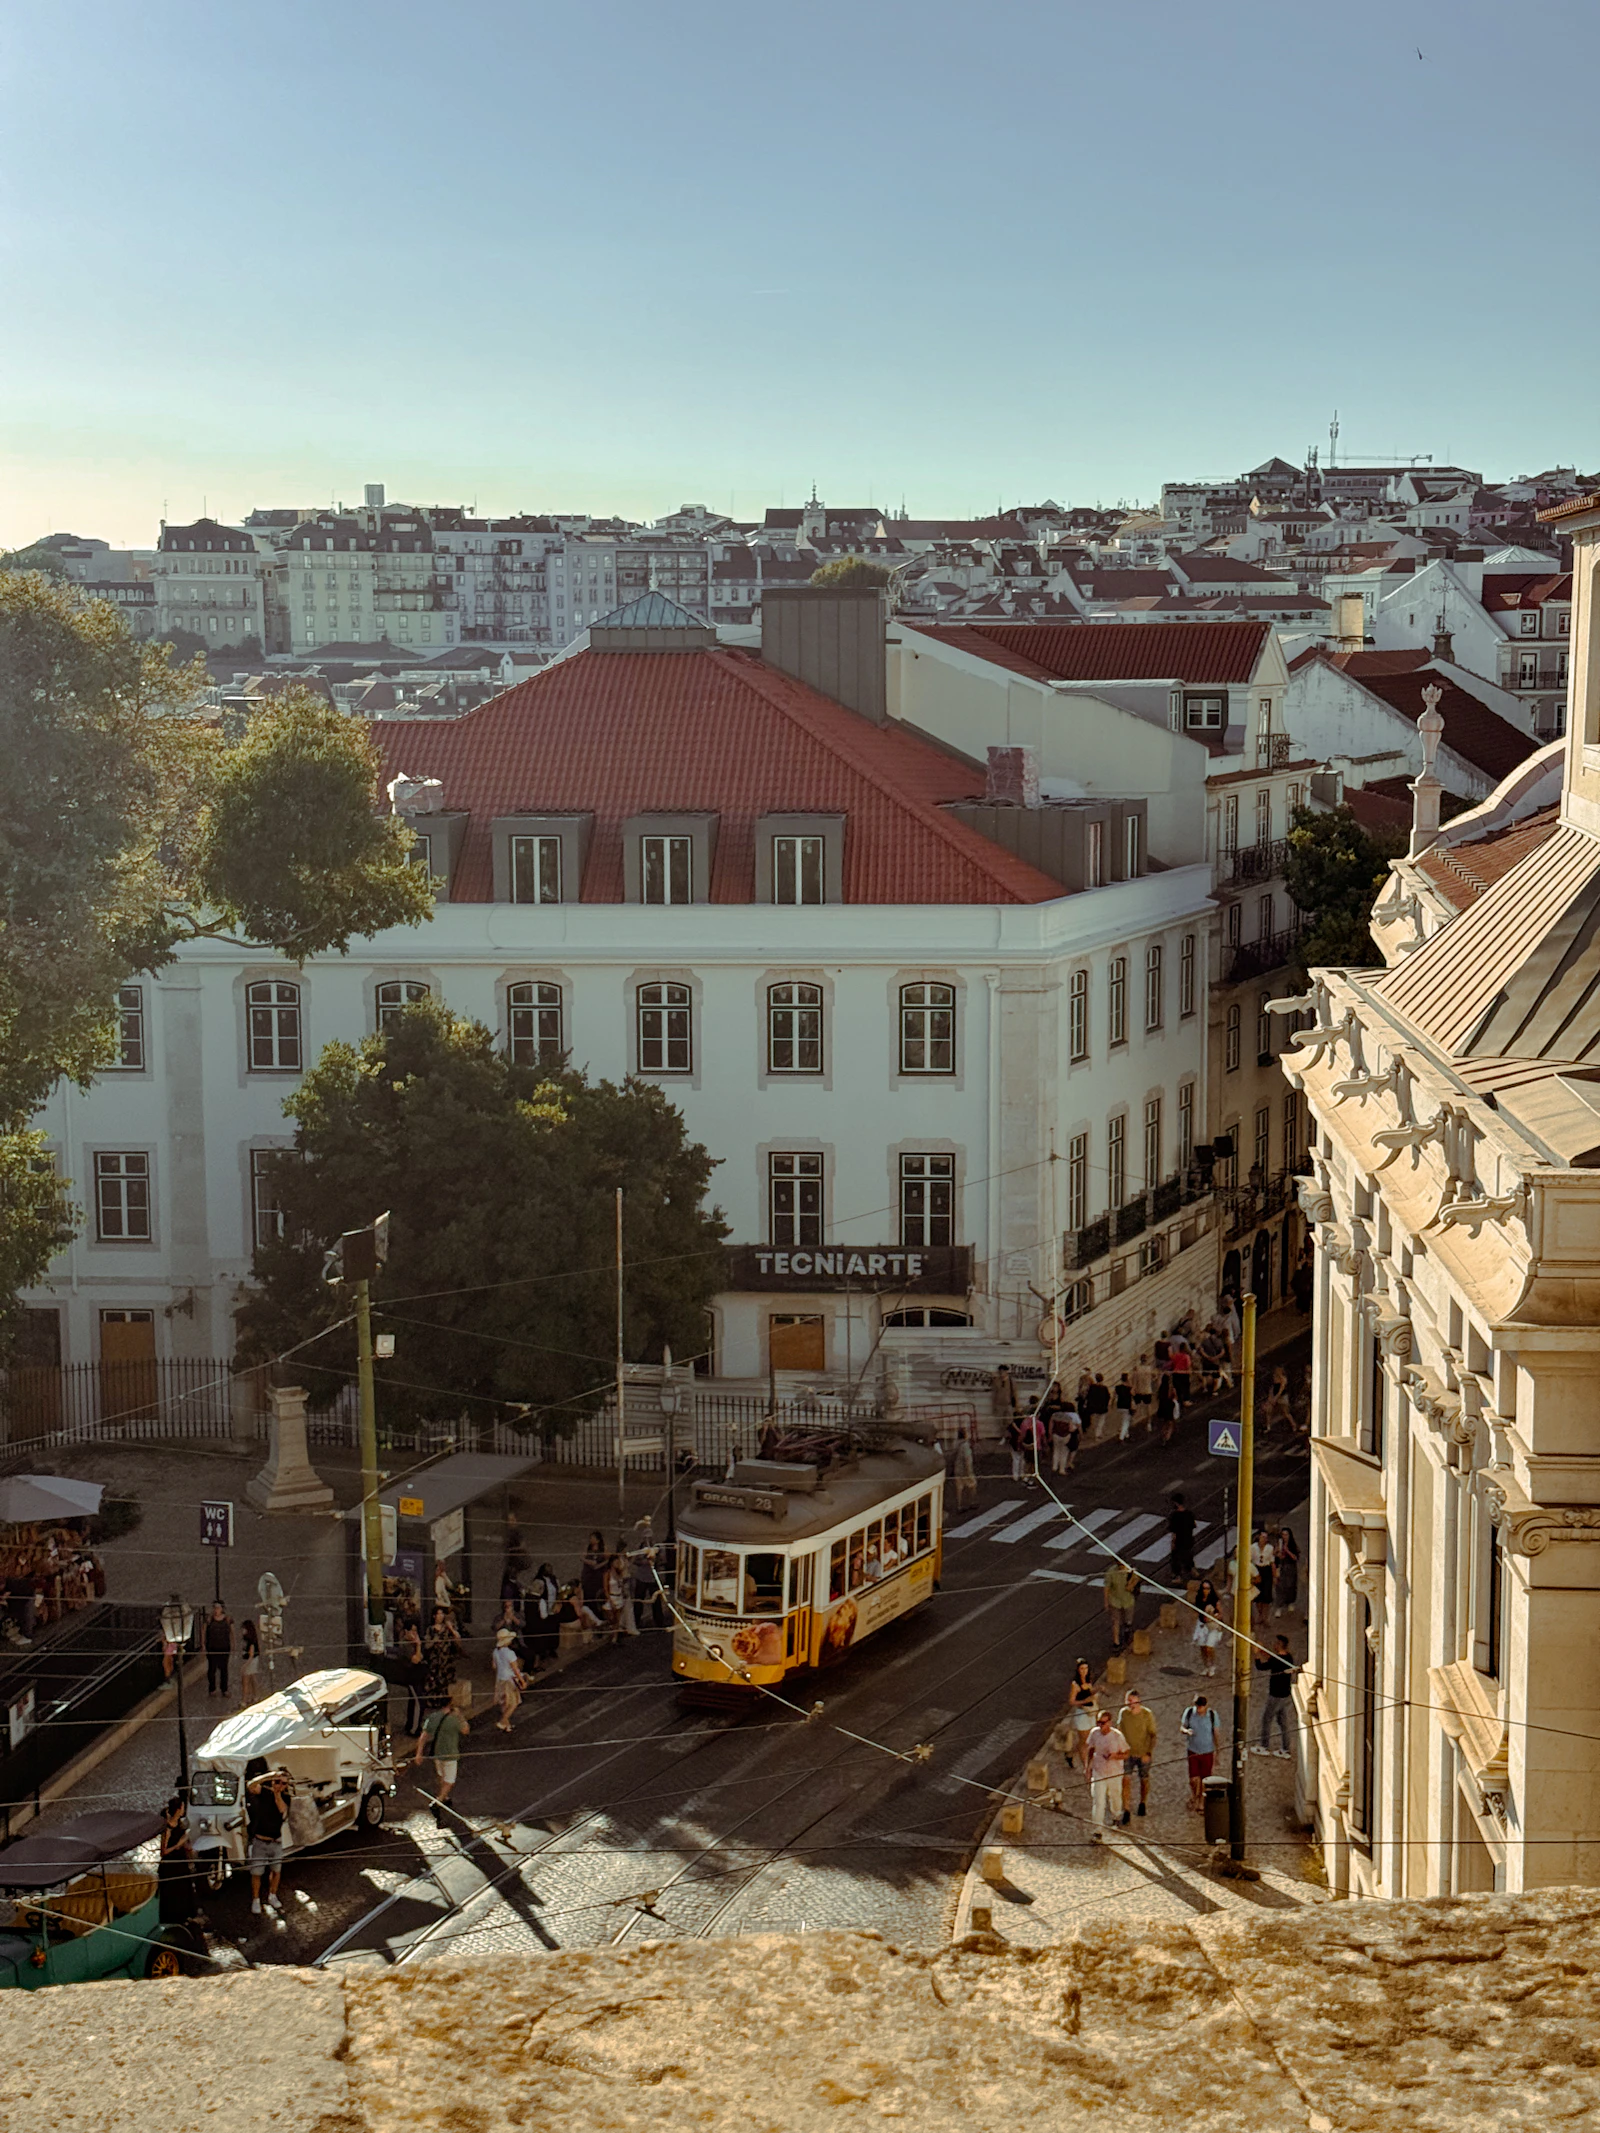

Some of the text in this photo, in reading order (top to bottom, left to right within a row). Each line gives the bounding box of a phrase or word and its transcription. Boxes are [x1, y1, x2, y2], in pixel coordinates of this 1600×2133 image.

[755, 1252, 922, 1276] TECNIARTE
[755, 1497, 772, 1510] 28
[204, 1507, 225, 1520] WC
